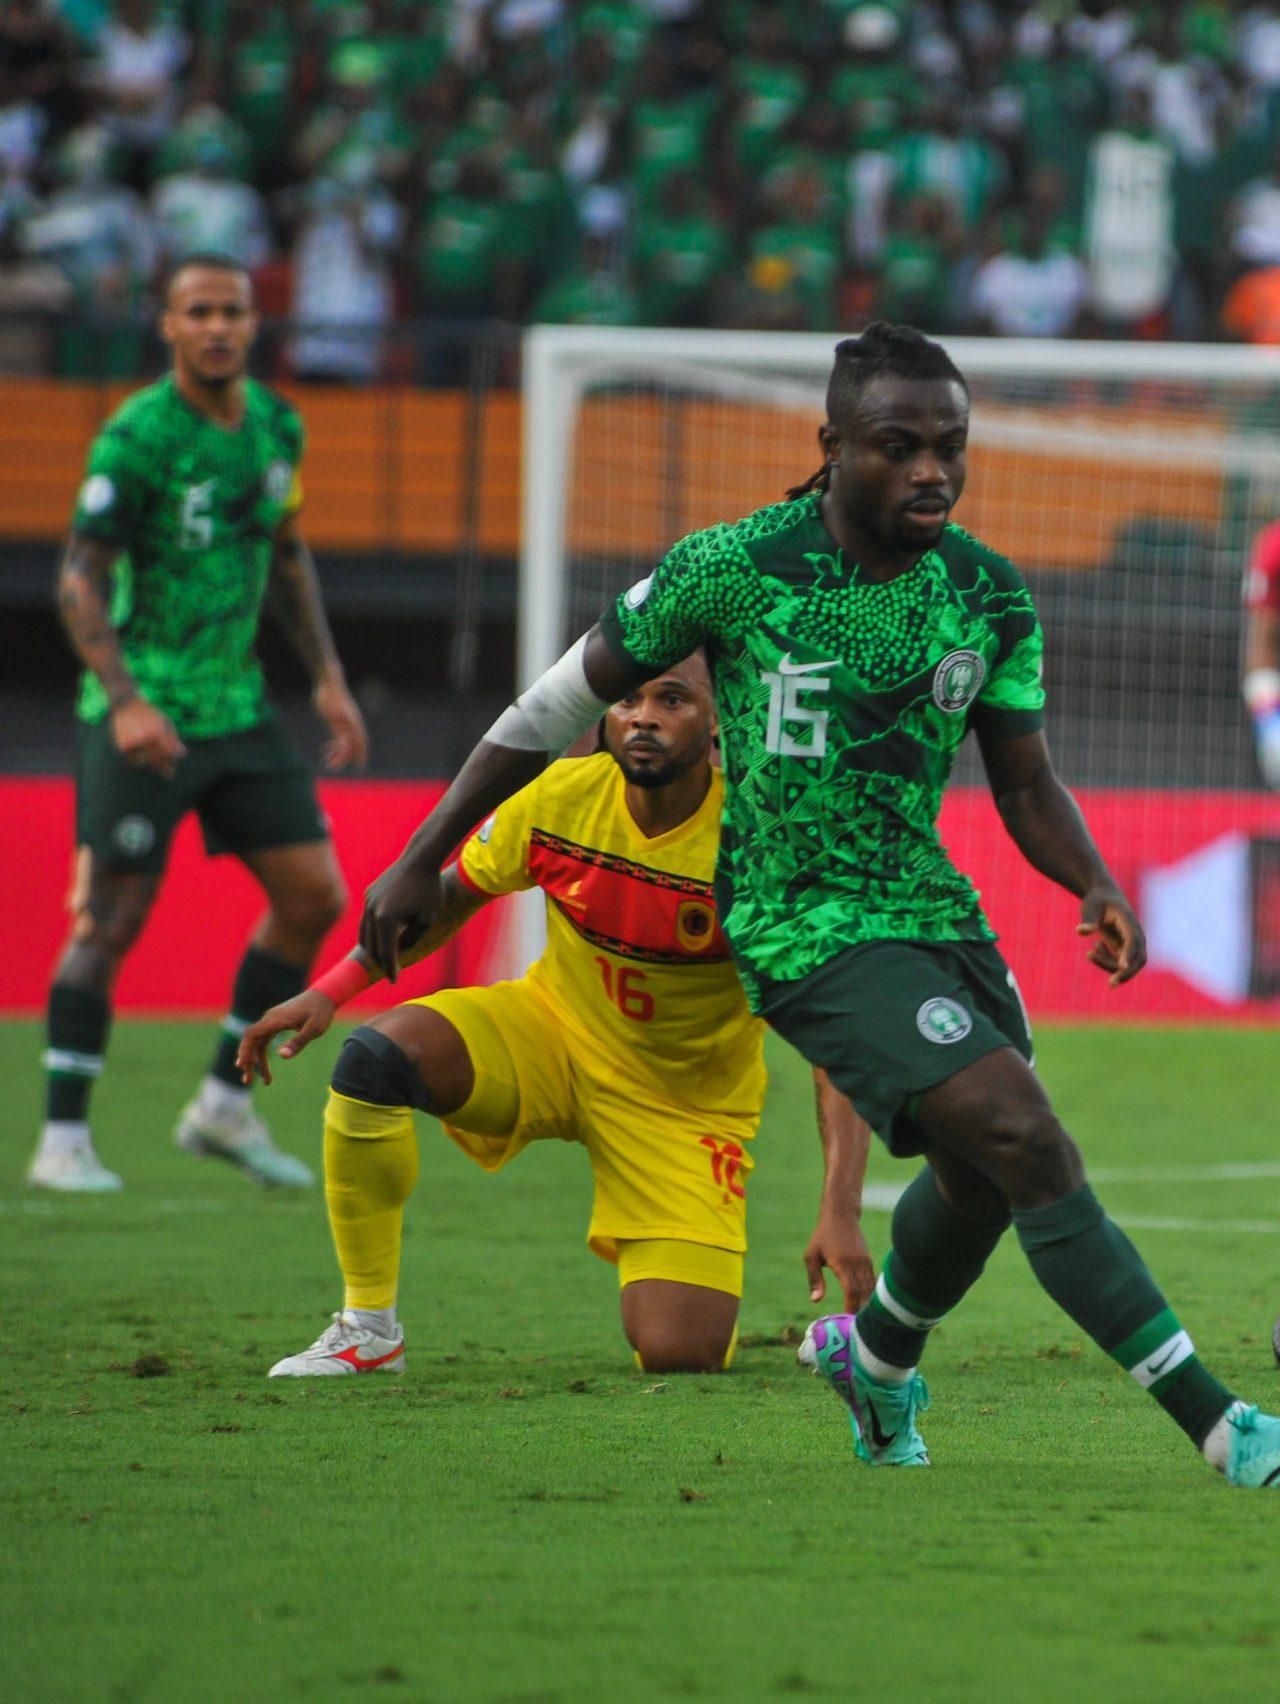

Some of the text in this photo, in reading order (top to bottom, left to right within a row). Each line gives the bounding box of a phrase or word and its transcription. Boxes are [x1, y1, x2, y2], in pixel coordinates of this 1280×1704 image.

[180, 490, 214, 551] 5
[760, 671, 831, 758] 15
[594, 955, 656, 1023] 16
